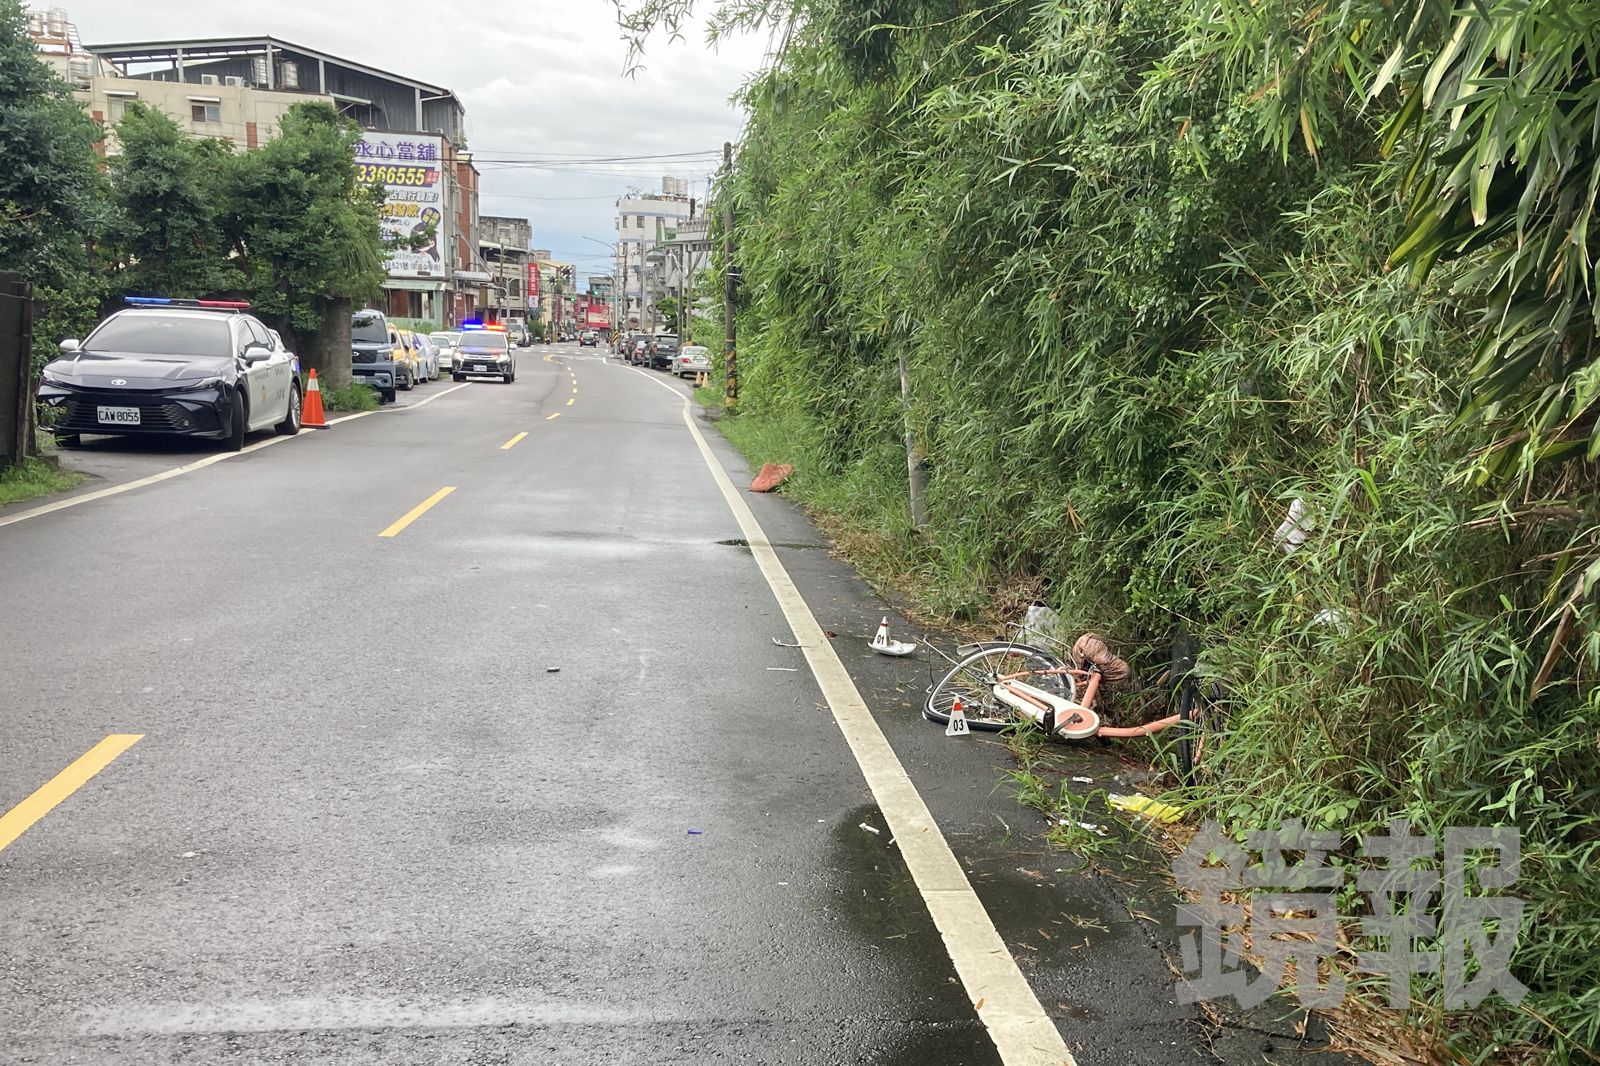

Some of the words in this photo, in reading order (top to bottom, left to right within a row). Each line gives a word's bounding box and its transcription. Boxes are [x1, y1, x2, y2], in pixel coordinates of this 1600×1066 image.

[355, 140, 435, 161] 永心當舖
[356, 165, 425, 185] 3366555
[877, 634, 885, 645] 01
[953, 719, 964, 731] 03
